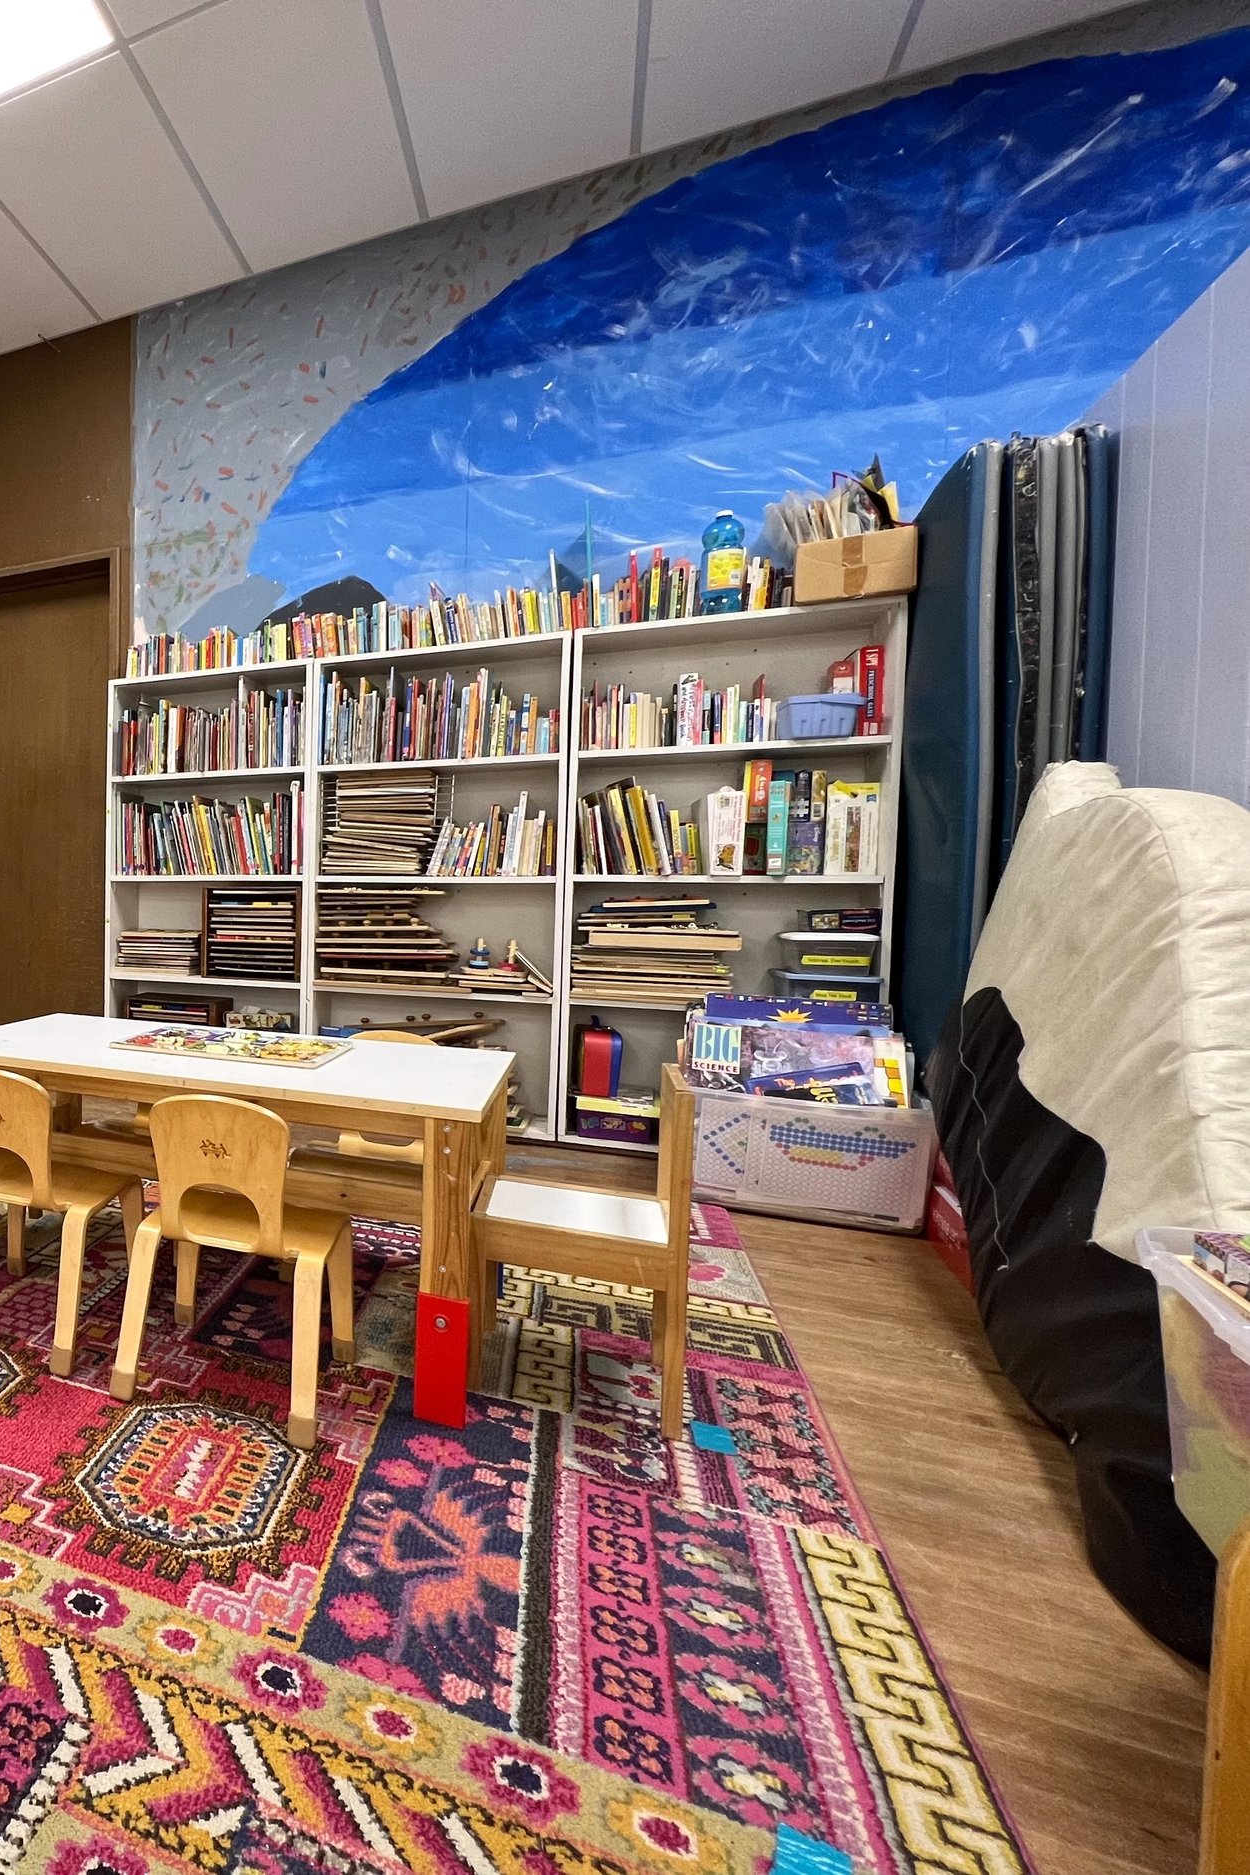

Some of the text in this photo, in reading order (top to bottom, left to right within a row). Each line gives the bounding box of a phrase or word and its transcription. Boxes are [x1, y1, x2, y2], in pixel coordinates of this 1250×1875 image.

[865, 653, 879, 666] SPY
[696, 1025, 739, 1062] BIG
[694, 1062, 738, 1073] SCIENCE
